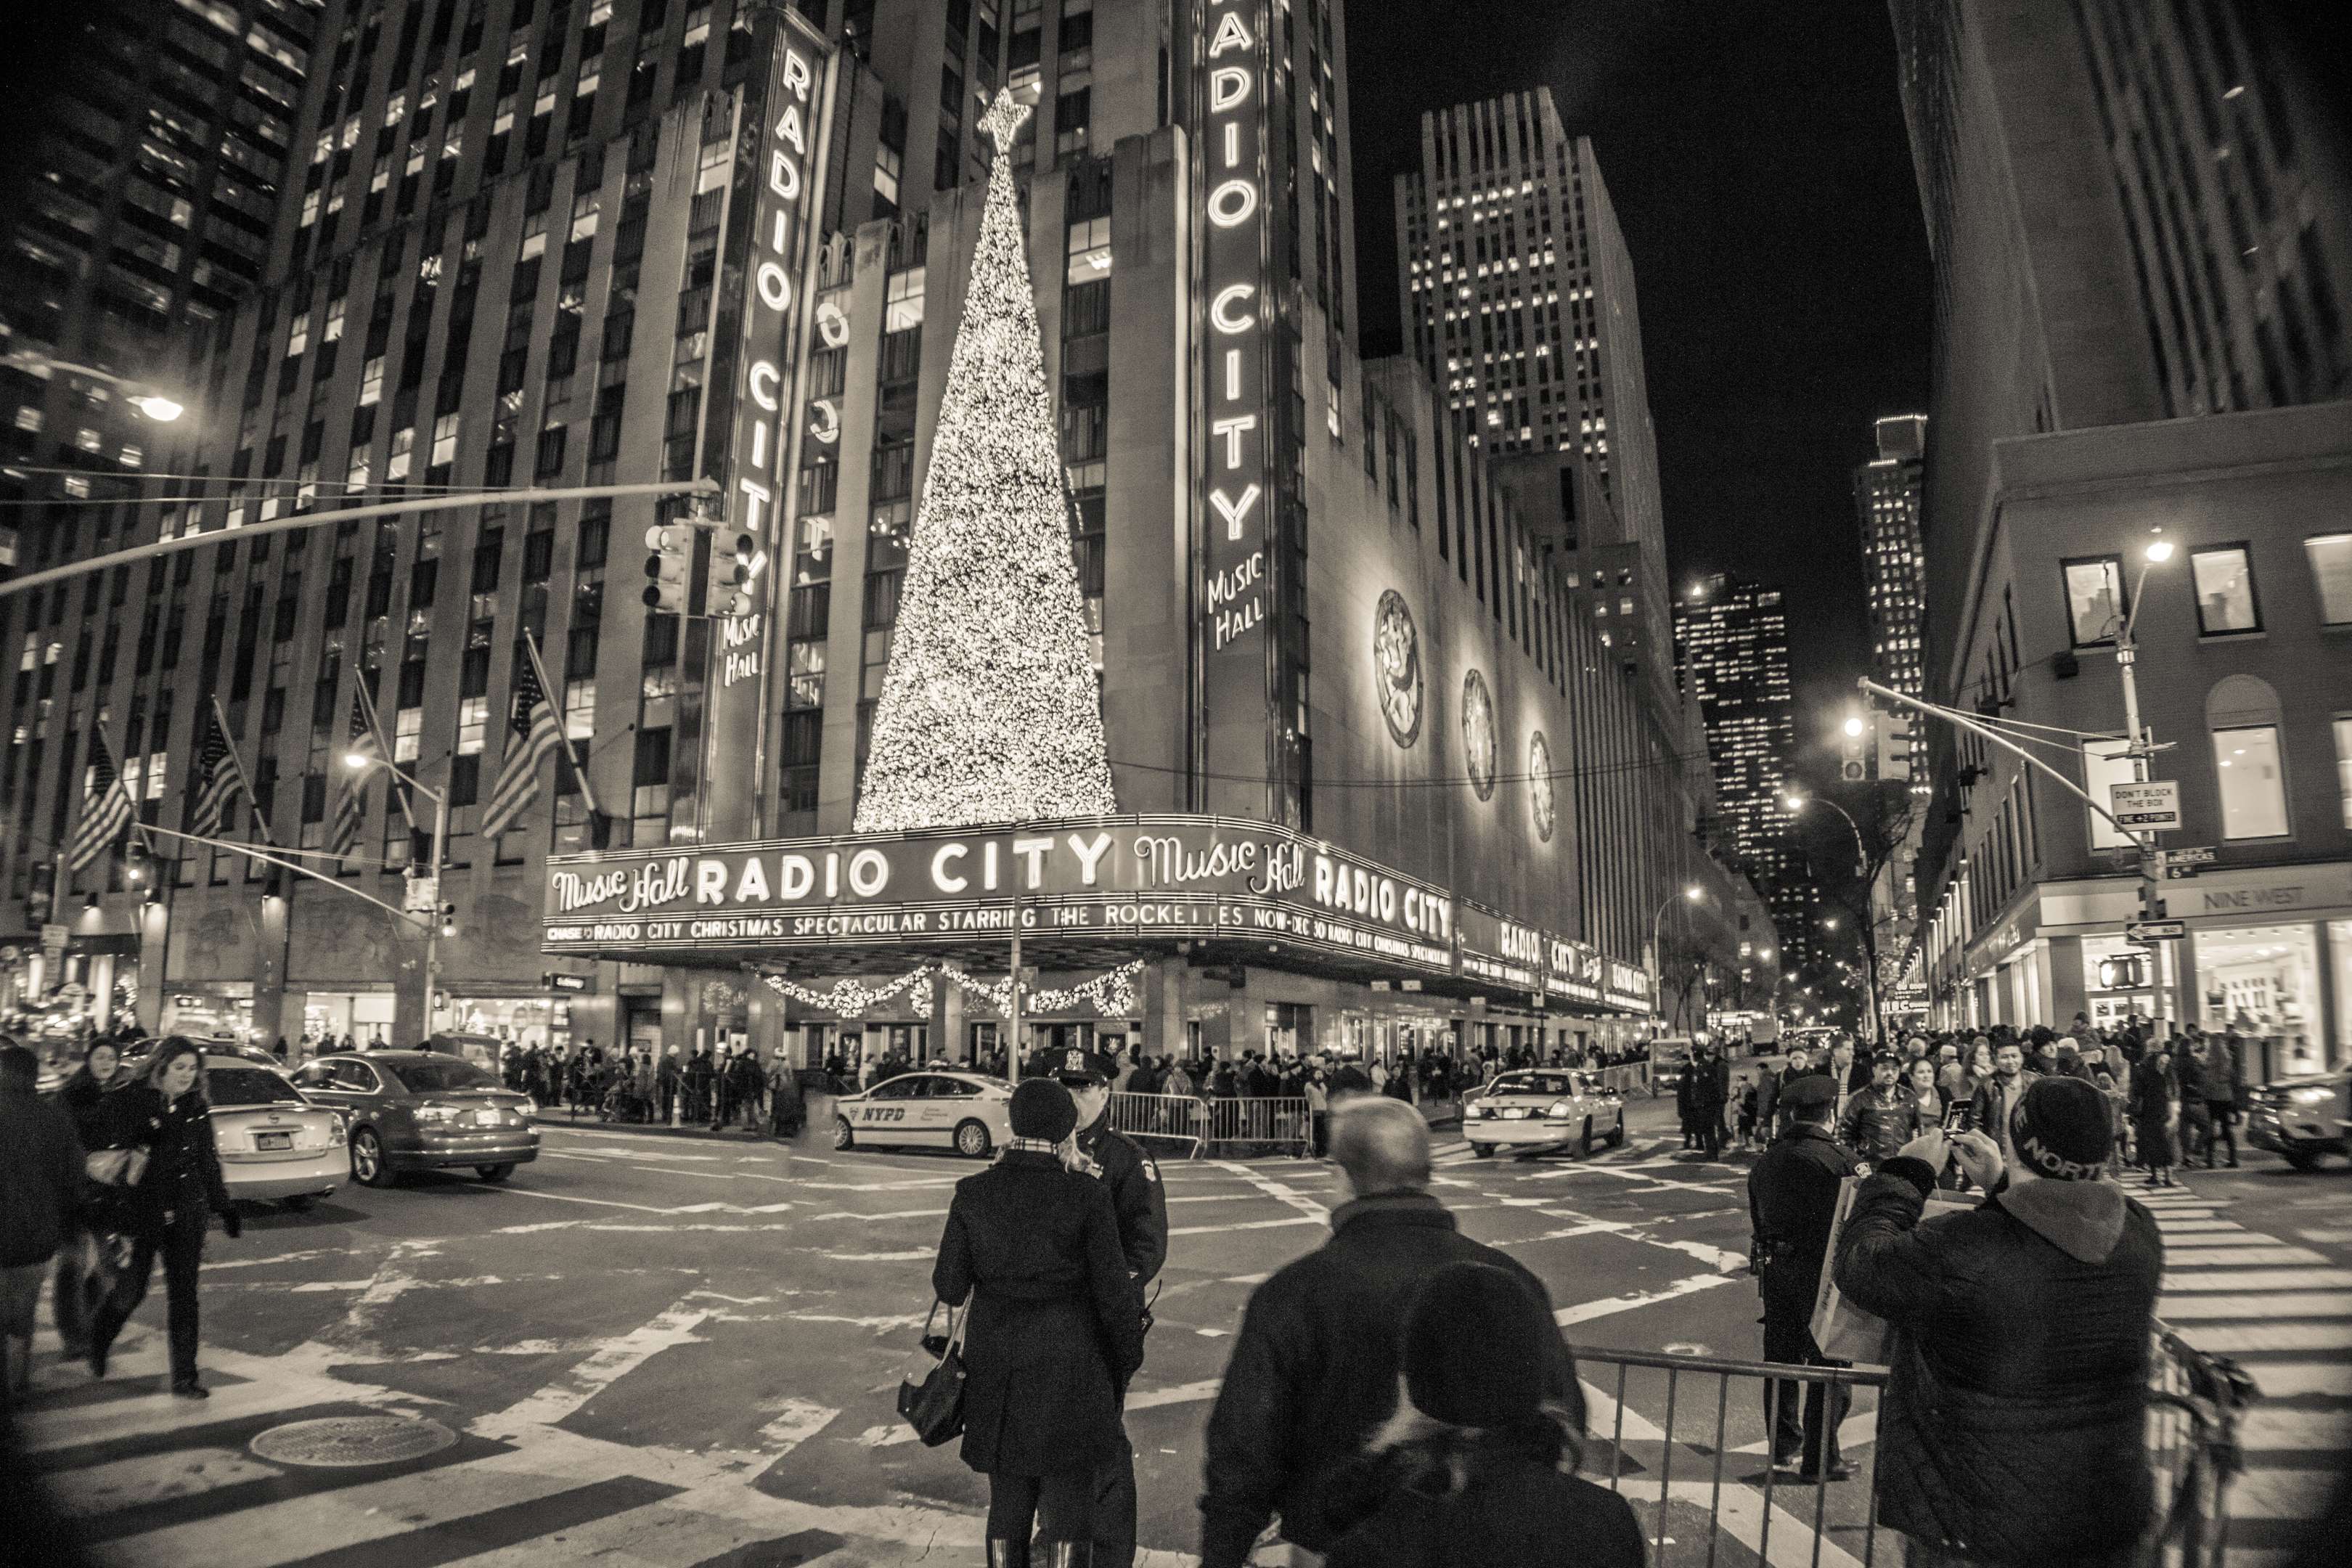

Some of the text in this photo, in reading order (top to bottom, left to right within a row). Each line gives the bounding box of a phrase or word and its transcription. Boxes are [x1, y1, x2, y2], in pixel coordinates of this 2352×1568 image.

[1207, 0, 1260, 540] ADIO CITY
[740, 48, 811, 595] RADIO CITY
[1207, 552, 1263, 615] MUSIC
[1215, 597, 1264, 651] HALL
[725, 651, 759, 687] HALL
[2127, 799, 2163, 808] THE BOX
[2144, 788, 2173, 797] BLOCK
[2168, 852, 2215, 862] AMERICAS
[552, 832, 1451, 938] Music Hall RADIO CITY Music Hall RADIO CITY
[2204, 886, 2305, 909] NINE WEST
[547, 927, 582, 941] CHASE
[594, 923, 640, 941] RADIO
[647, 922, 683, 939] CITY
[690, 918, 784, 939] CHRISTMAS
[793, 912, 927, 936] SPECTACULAR
[1051, 906, 1089, 926] THE
[1313, 920, 1327, 939] 30
[1328, 923, 1353, 944] RADIO
[1355, 931, 1373, 949] CITY
[1500, 922, 1540, 964] RADIO
[1551, 940, 1575, 975] CITY
[862, 1108, 905, 1122] NYPD
